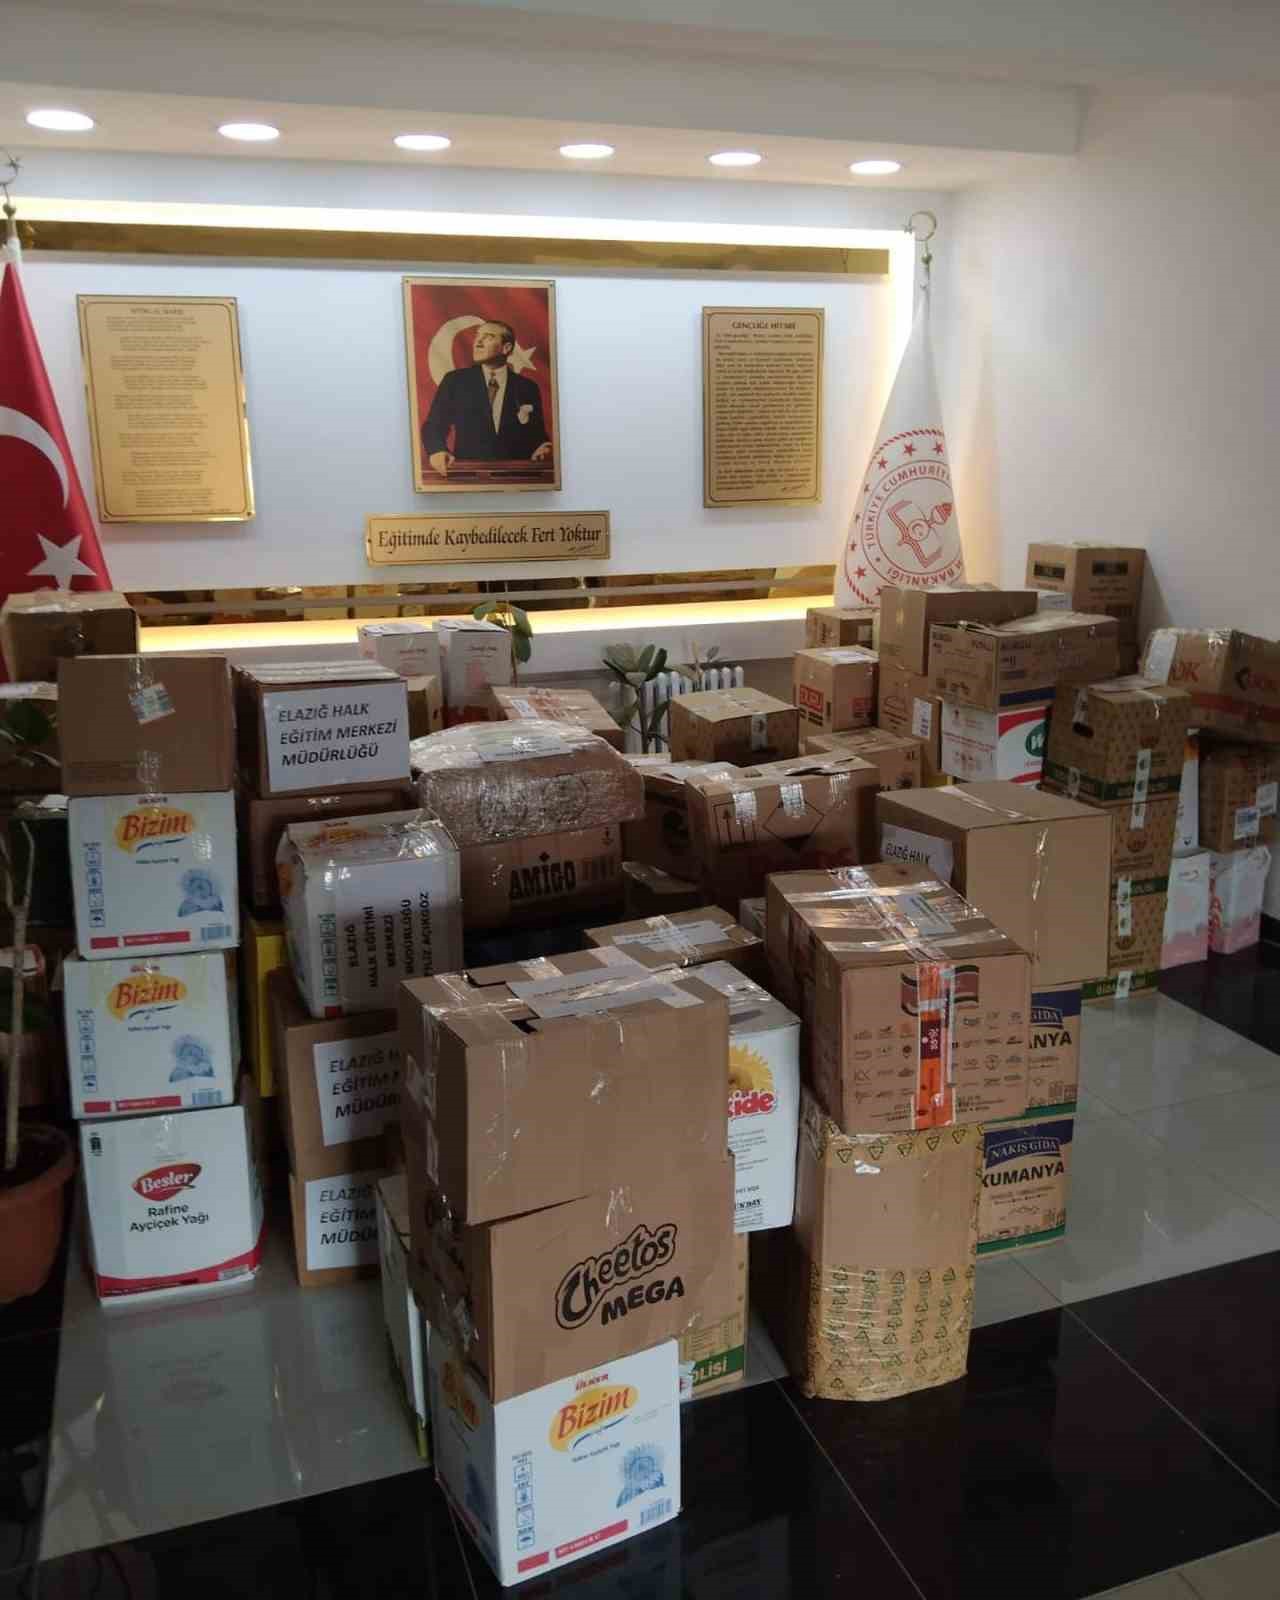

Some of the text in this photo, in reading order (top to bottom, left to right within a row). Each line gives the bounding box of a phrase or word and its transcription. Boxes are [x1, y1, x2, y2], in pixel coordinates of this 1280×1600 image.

[378, 523, 602, 554] Eğitimde Kaybedilecek Fert Yoktur
[279, 703, 369, 722] ELAZIĞ HALK
[280, 719, 399, 745] EĞİTİM MERKEZİ
[282, 742, 379, 767] MÜDÜRLÜĞÜ
[122, 812, 188, 841] Bizim
[115, 980, 180, 1008] Bizim
[141, 1172, 195, 1194] Besler
[148, 1204, 189, 1217] Rafine
[182, 1211, 209, 1225] Yağı
[557, 1226, 675, 1327] Cheetos
[601, 1276, 685, 1326] MEGA
[558, 1387, 631, 1440] Bizim
